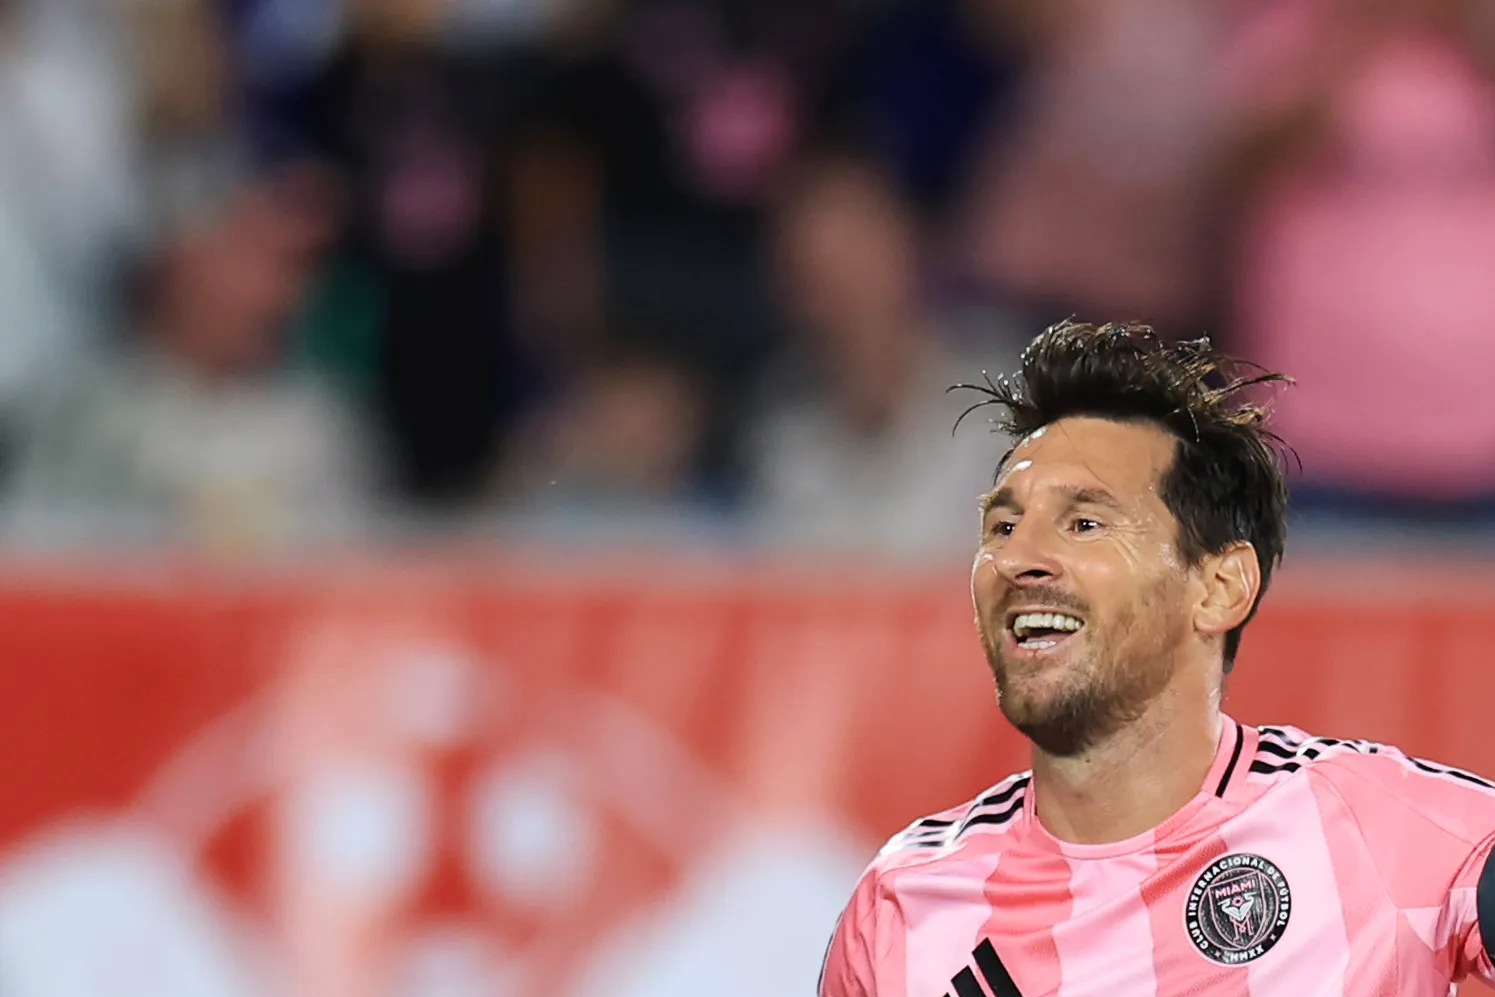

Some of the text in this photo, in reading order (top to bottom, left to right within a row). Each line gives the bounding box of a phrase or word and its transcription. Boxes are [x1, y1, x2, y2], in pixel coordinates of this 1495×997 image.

[1267, 866, 1281, 881] DE
[1188, 856, 1265, 917] INTERNACIONAL
[1215, 879, 1256, 899] MIAMI
[1189, 921, 1209, 950] CLUB
